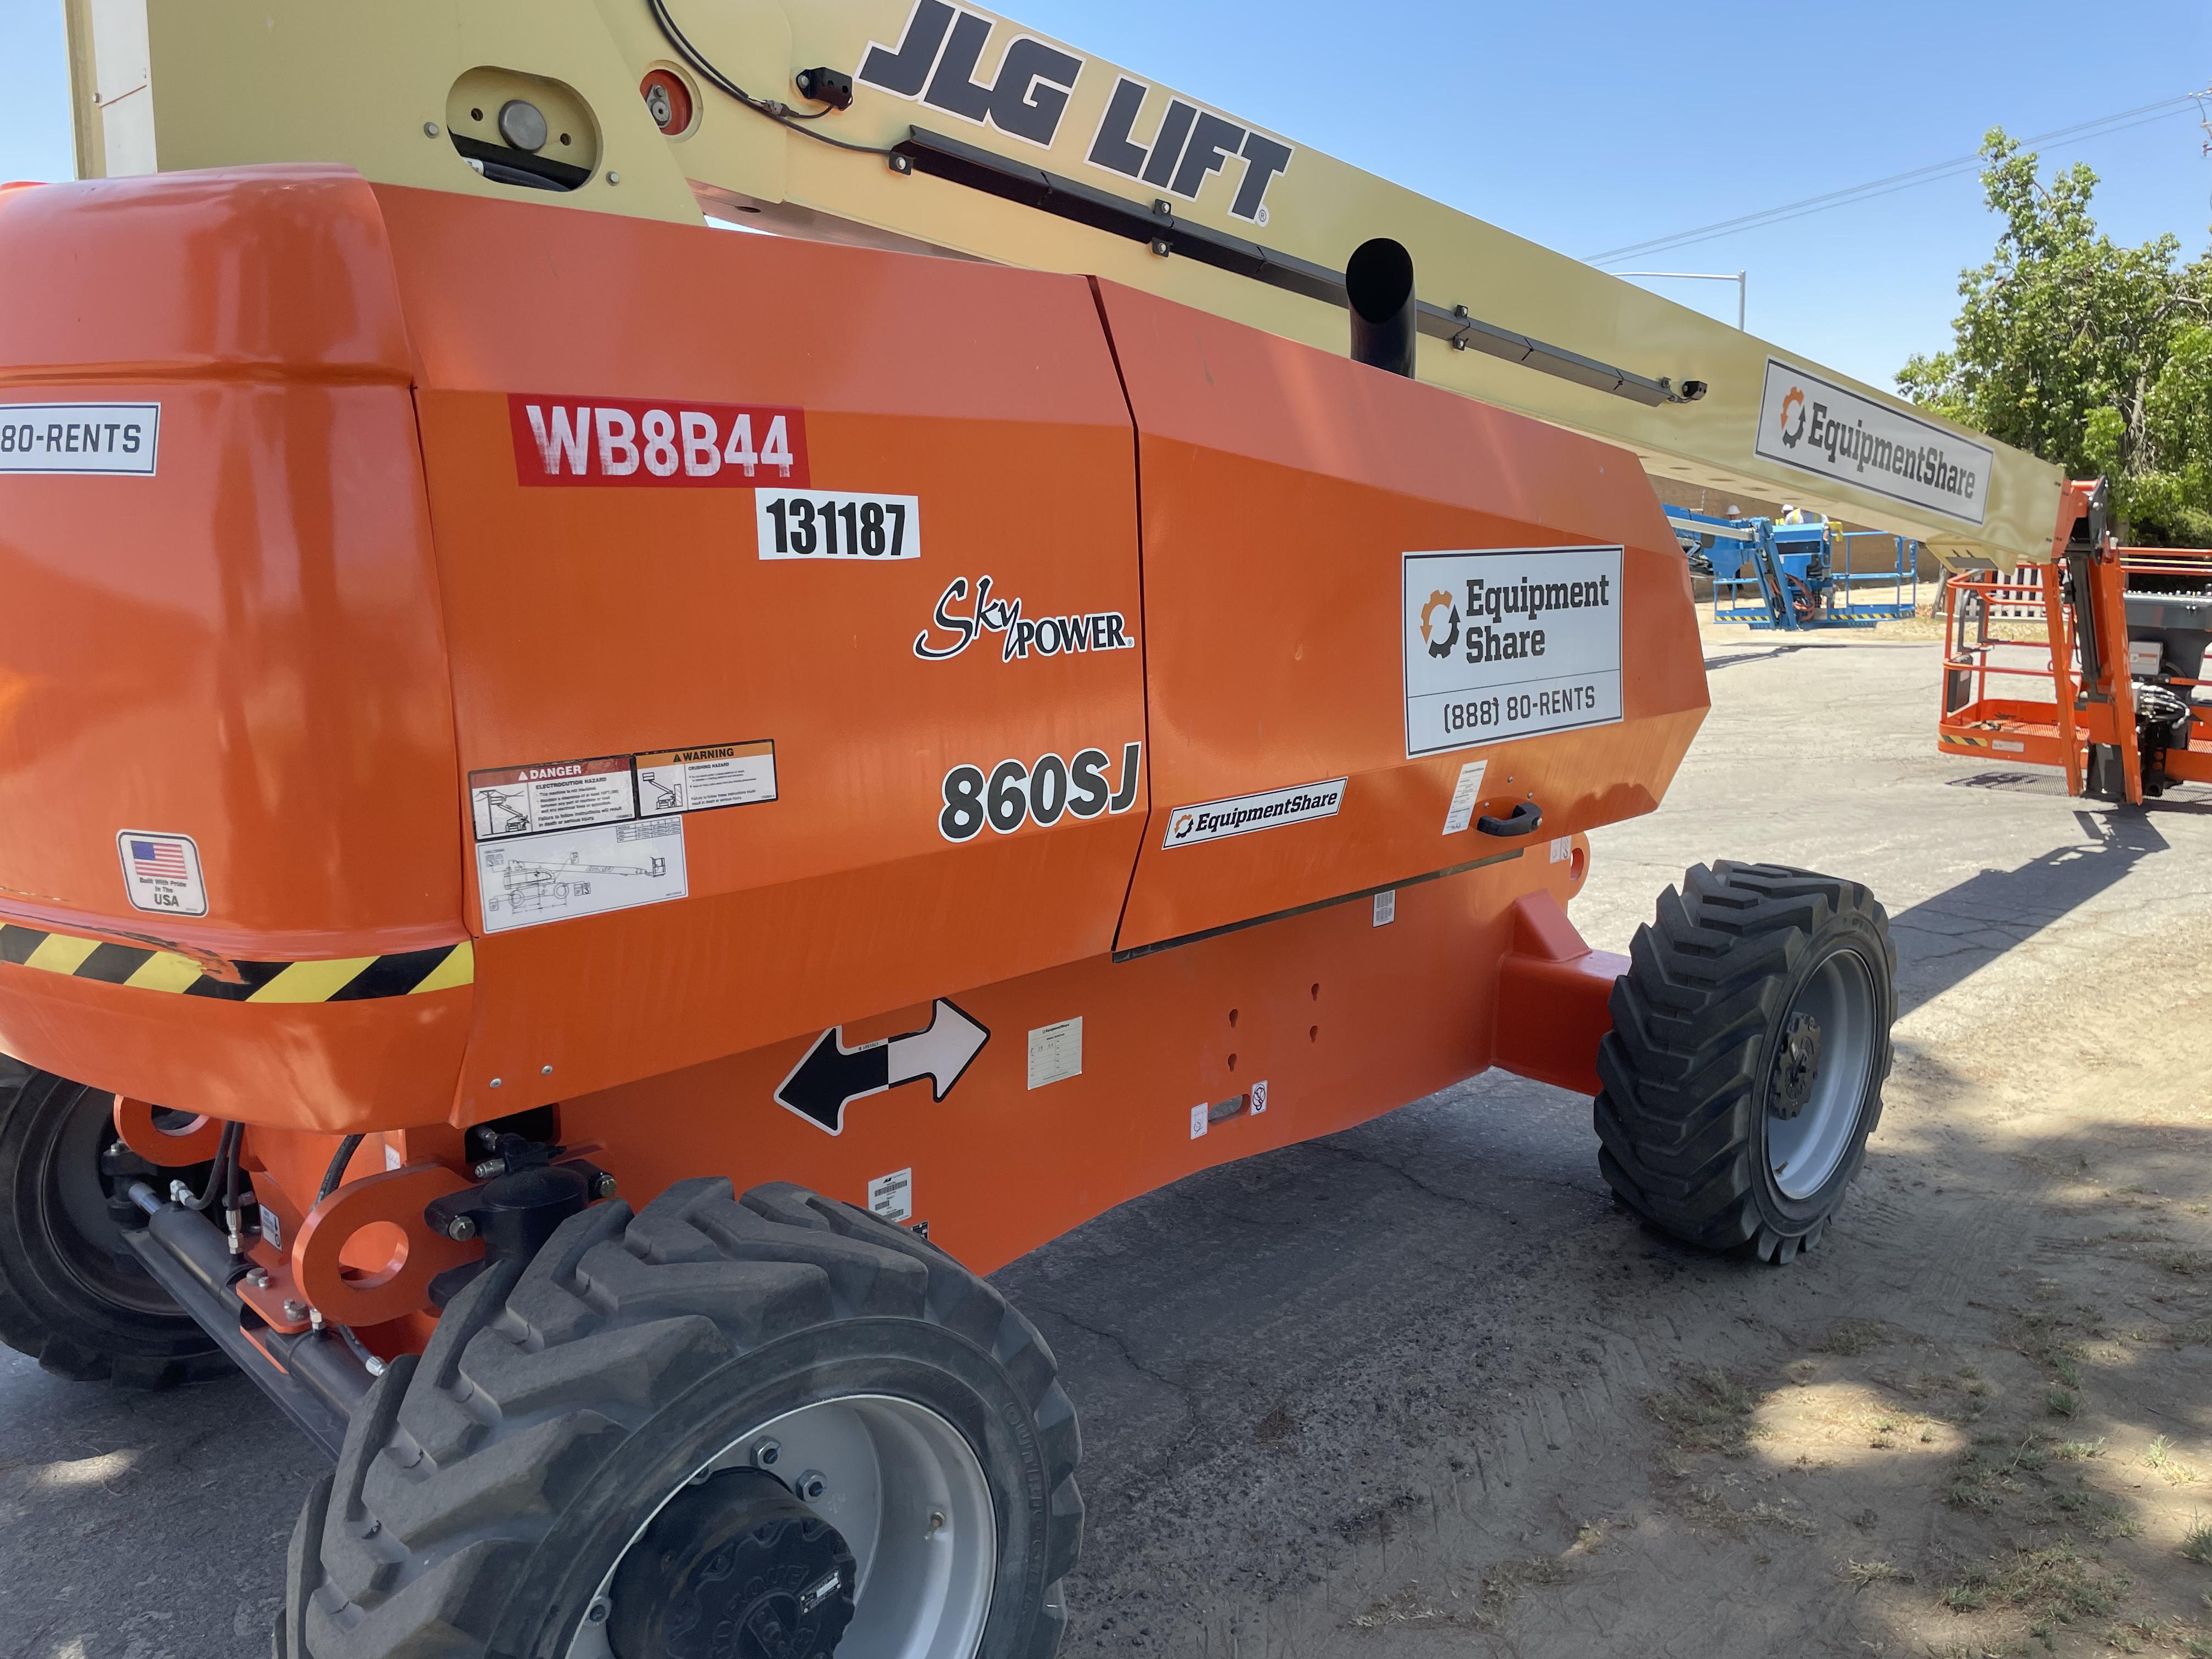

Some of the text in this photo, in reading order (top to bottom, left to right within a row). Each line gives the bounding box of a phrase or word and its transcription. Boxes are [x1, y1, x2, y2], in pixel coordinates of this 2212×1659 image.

[856, 0, 1084, 148] JLG
[1, 424, 141, 453] 80-RENTS
[526, 405, 793, 477] WB8B44
[1808, 402, 1975, 499] EquipmentShare
[766, 498, 905, 556] 131187
[1466, 574, 1609, 623] Equipment
[1466, 625, 1545, 663] Share
[1444, 686, 1595, 733] (888) 80-RENTS
[530, 765, 582, 779] DANGER
[683, 748, 733, 761] WARNING
[536, 780, 583, 789] ELECTROCUTION
[940, 743, 1140, 840] 860SJ
[1195, 793, 1338, 832] EquipmentShare
[154, 894, 179, 906] USA
